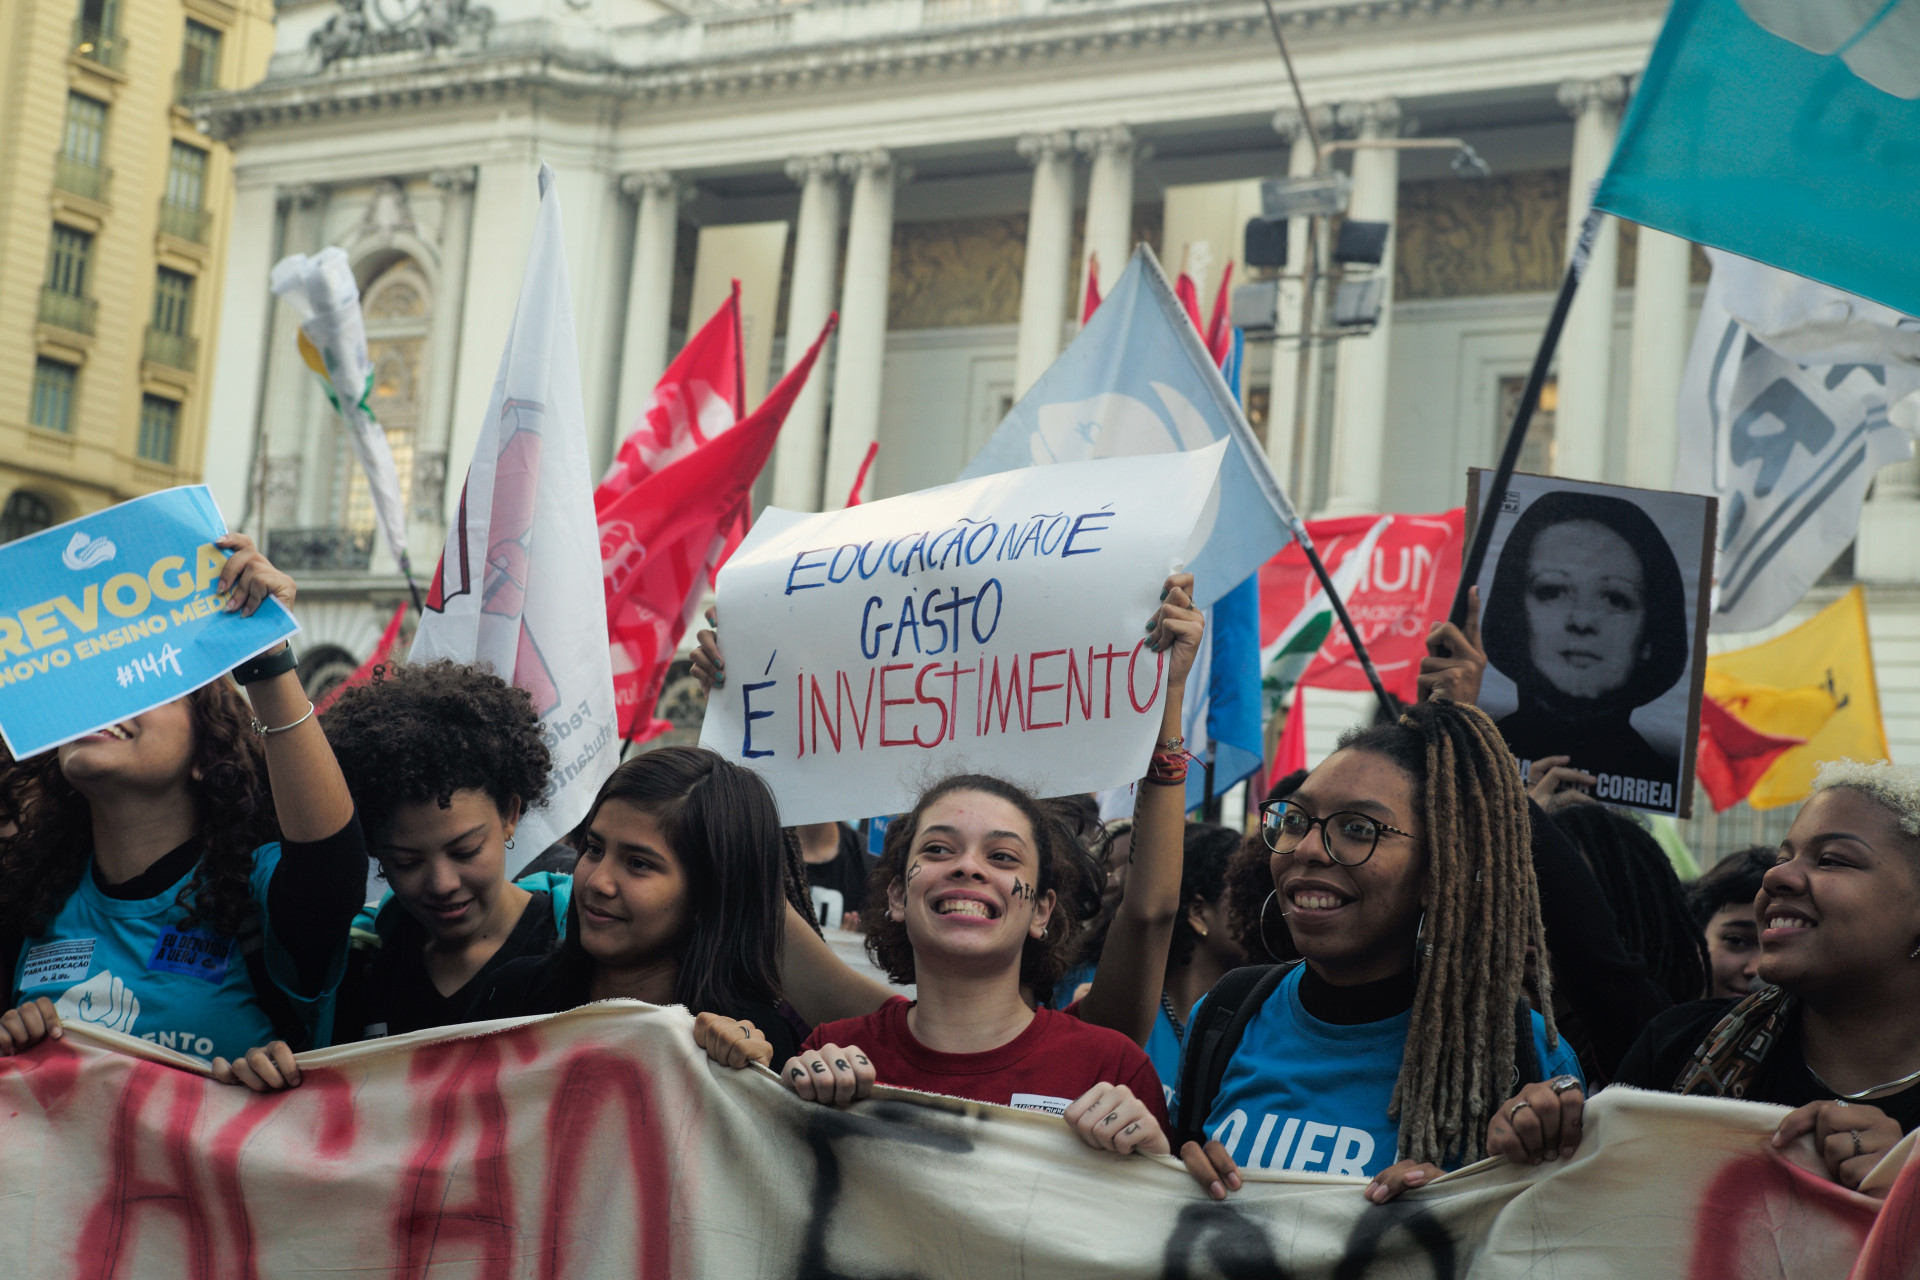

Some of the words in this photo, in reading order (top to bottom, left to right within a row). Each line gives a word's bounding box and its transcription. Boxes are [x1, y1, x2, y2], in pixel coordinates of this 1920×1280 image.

[997, 511, 1072, 562] NÃO
[1061, 502, 1116, 558] É
[0, 542, 227, 662] REVOGA
[0, 648, 72, 692] NOVO
[74, 614, 168, 661] ENSINO
[170, 585, 239, 627] MÉD
[116, 643, 182, 688] #14A
[742, 650, 777, 758] É
[797, 637, 1164, 759] INVESTIMENTO
[1596, 773, 1673, 808] CORREA
[48, 960, 89, 971] EDUCAÇÃO
[162, 934, 178, 948] EU
